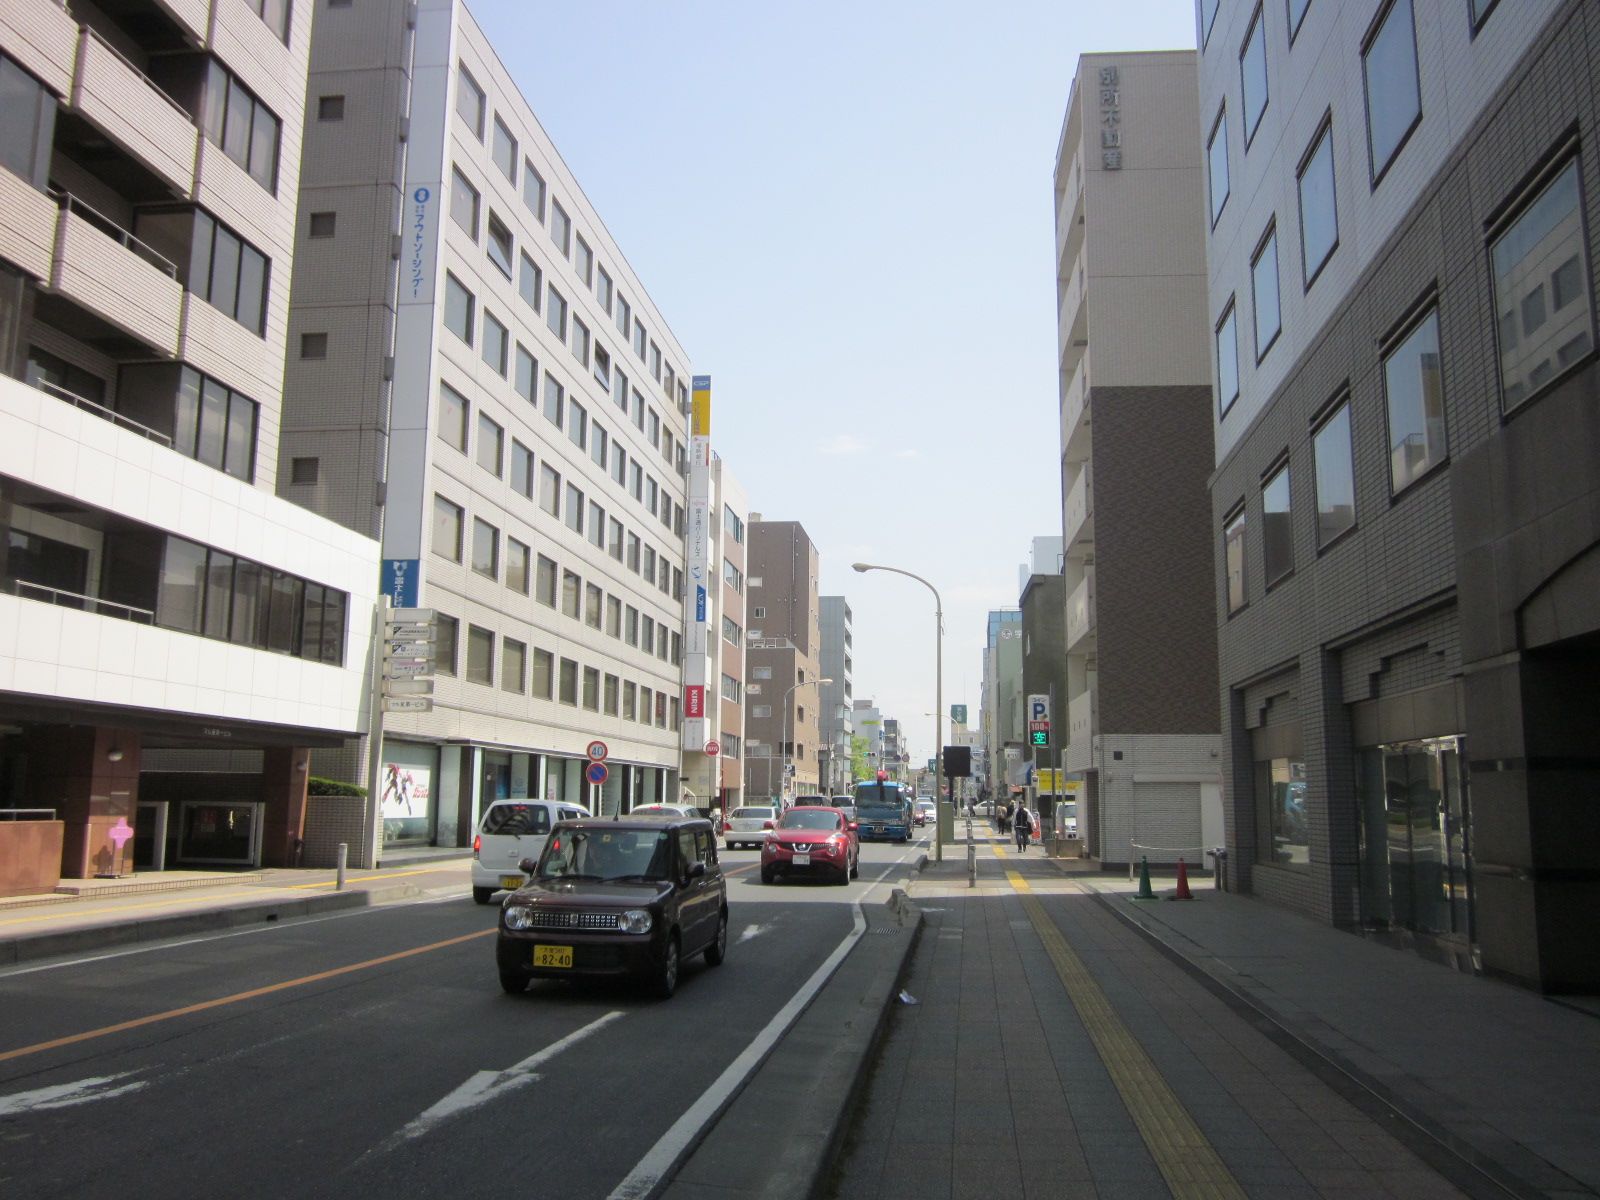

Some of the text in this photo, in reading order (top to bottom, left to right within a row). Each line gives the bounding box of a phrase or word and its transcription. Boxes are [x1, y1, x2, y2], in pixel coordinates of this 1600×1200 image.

[690, 689, 699, 714] KIRIN
[1033, 703, 1046, 720] P
[1033, 731, 1046, 745] 空
[592, 747, 603, 756] 40
